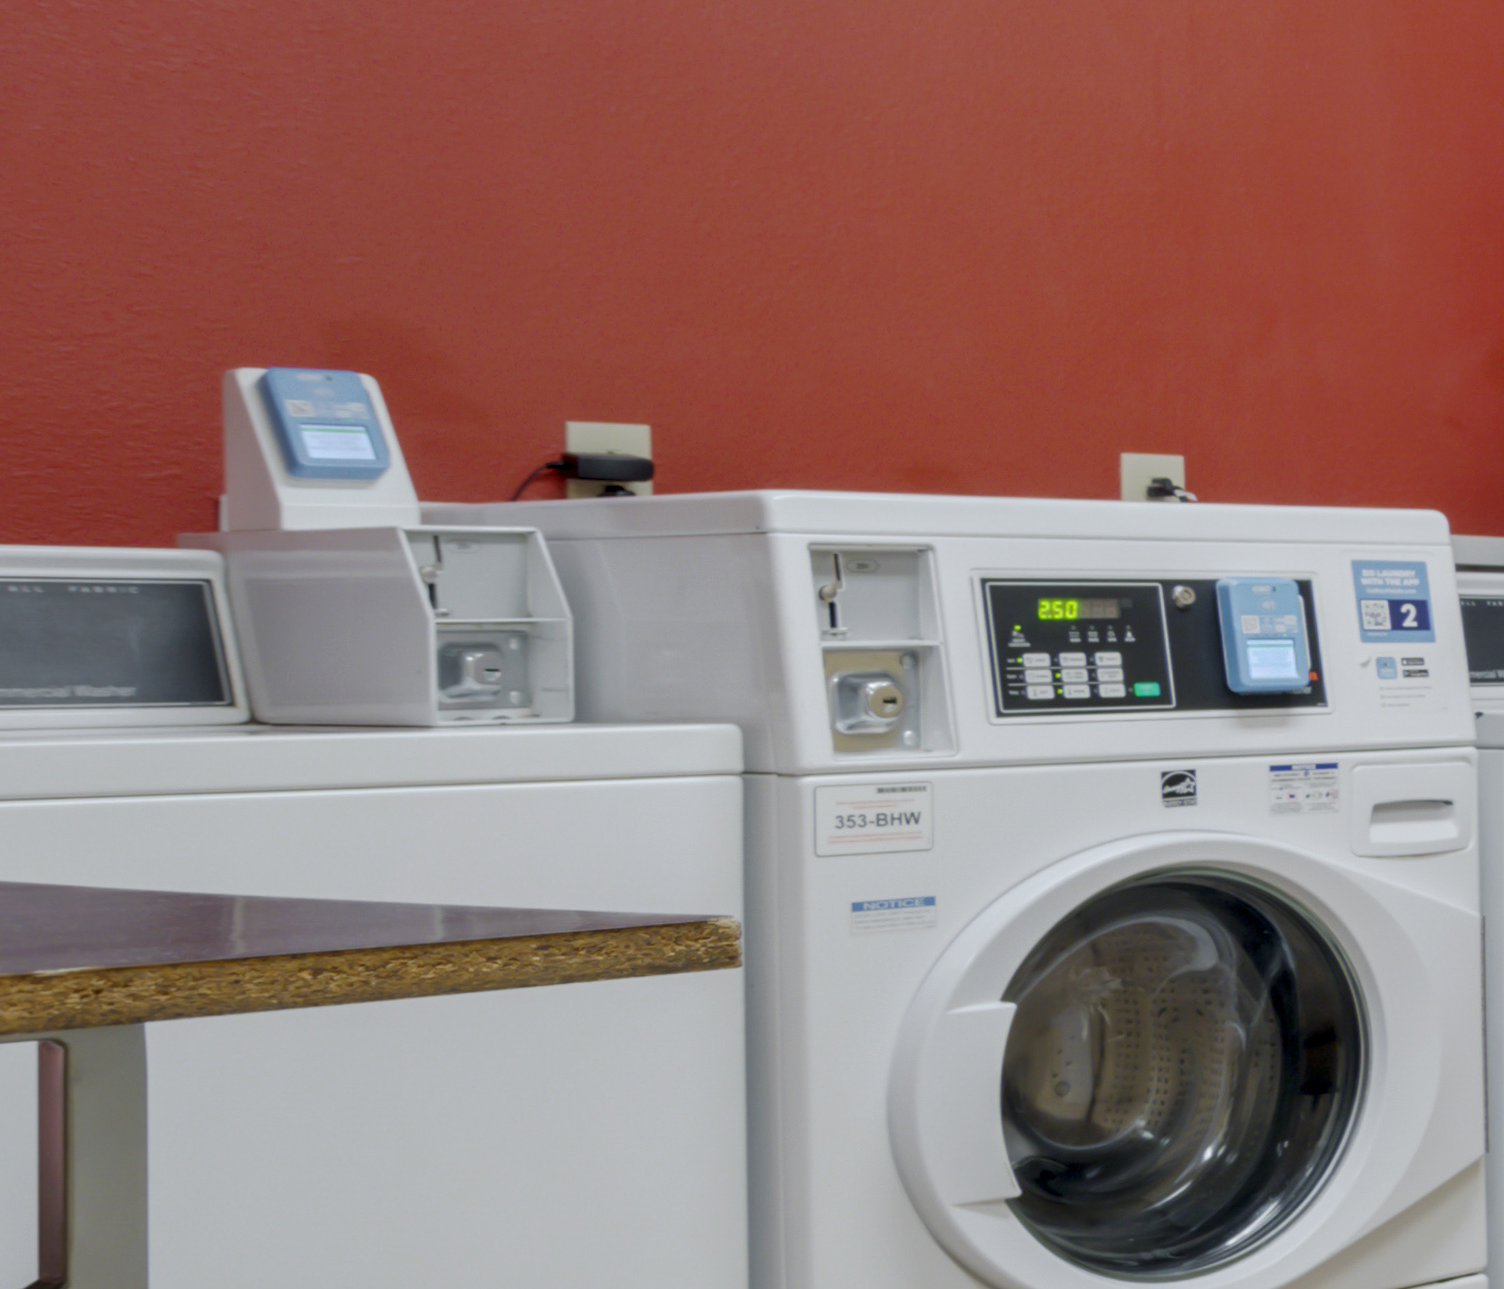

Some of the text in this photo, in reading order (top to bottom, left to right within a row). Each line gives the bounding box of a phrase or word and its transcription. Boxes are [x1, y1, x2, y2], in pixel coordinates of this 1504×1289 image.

[1400, 603, 1418, 628] 2
[835, 811, 921, 829] 353-BHW
[863, 899, 925, 910] NOTICE
